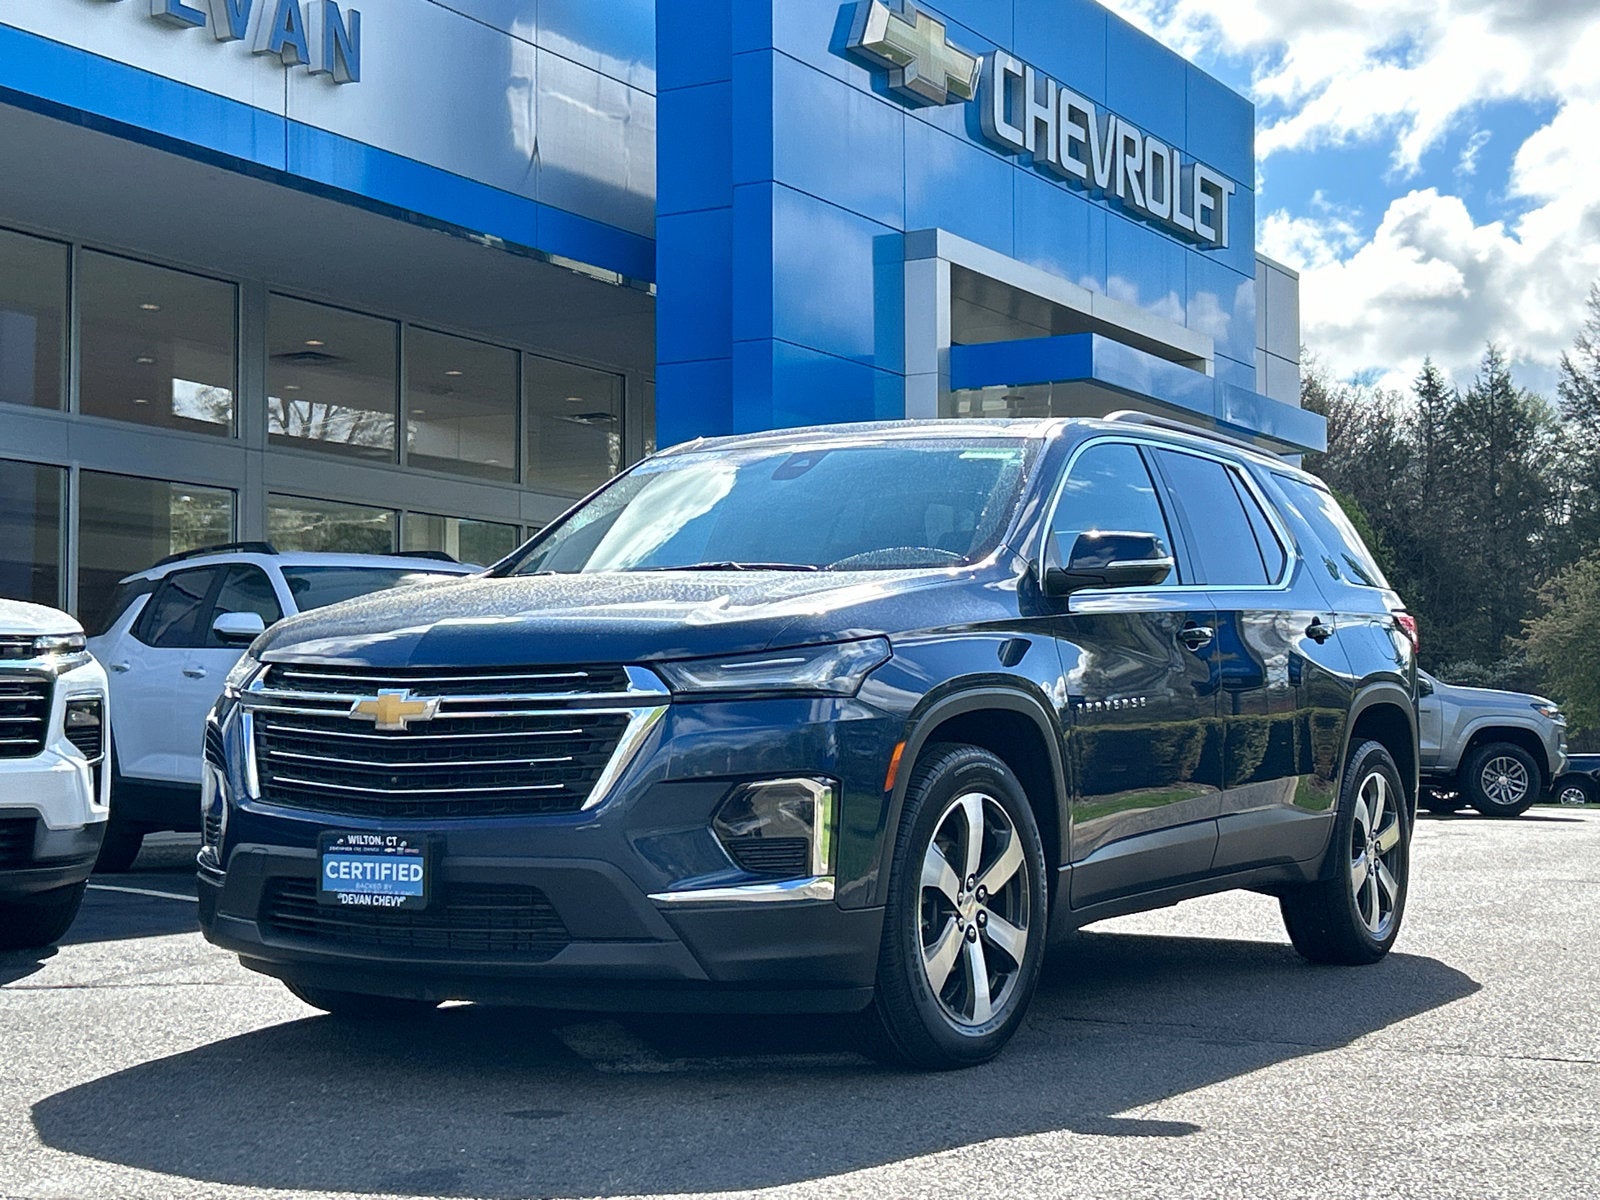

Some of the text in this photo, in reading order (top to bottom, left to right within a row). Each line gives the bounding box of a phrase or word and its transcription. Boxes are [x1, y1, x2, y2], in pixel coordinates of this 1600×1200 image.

[982, 49, 1236, 249] CHEVROLET
[1077, 697, 1146, 714] TRAVERSE
[347, 835, 398, 846] WILTON, CT
[325, 861, 424, 882] CERTIFIED
[341, 893, 401, 907] DEVAN CHEVY
